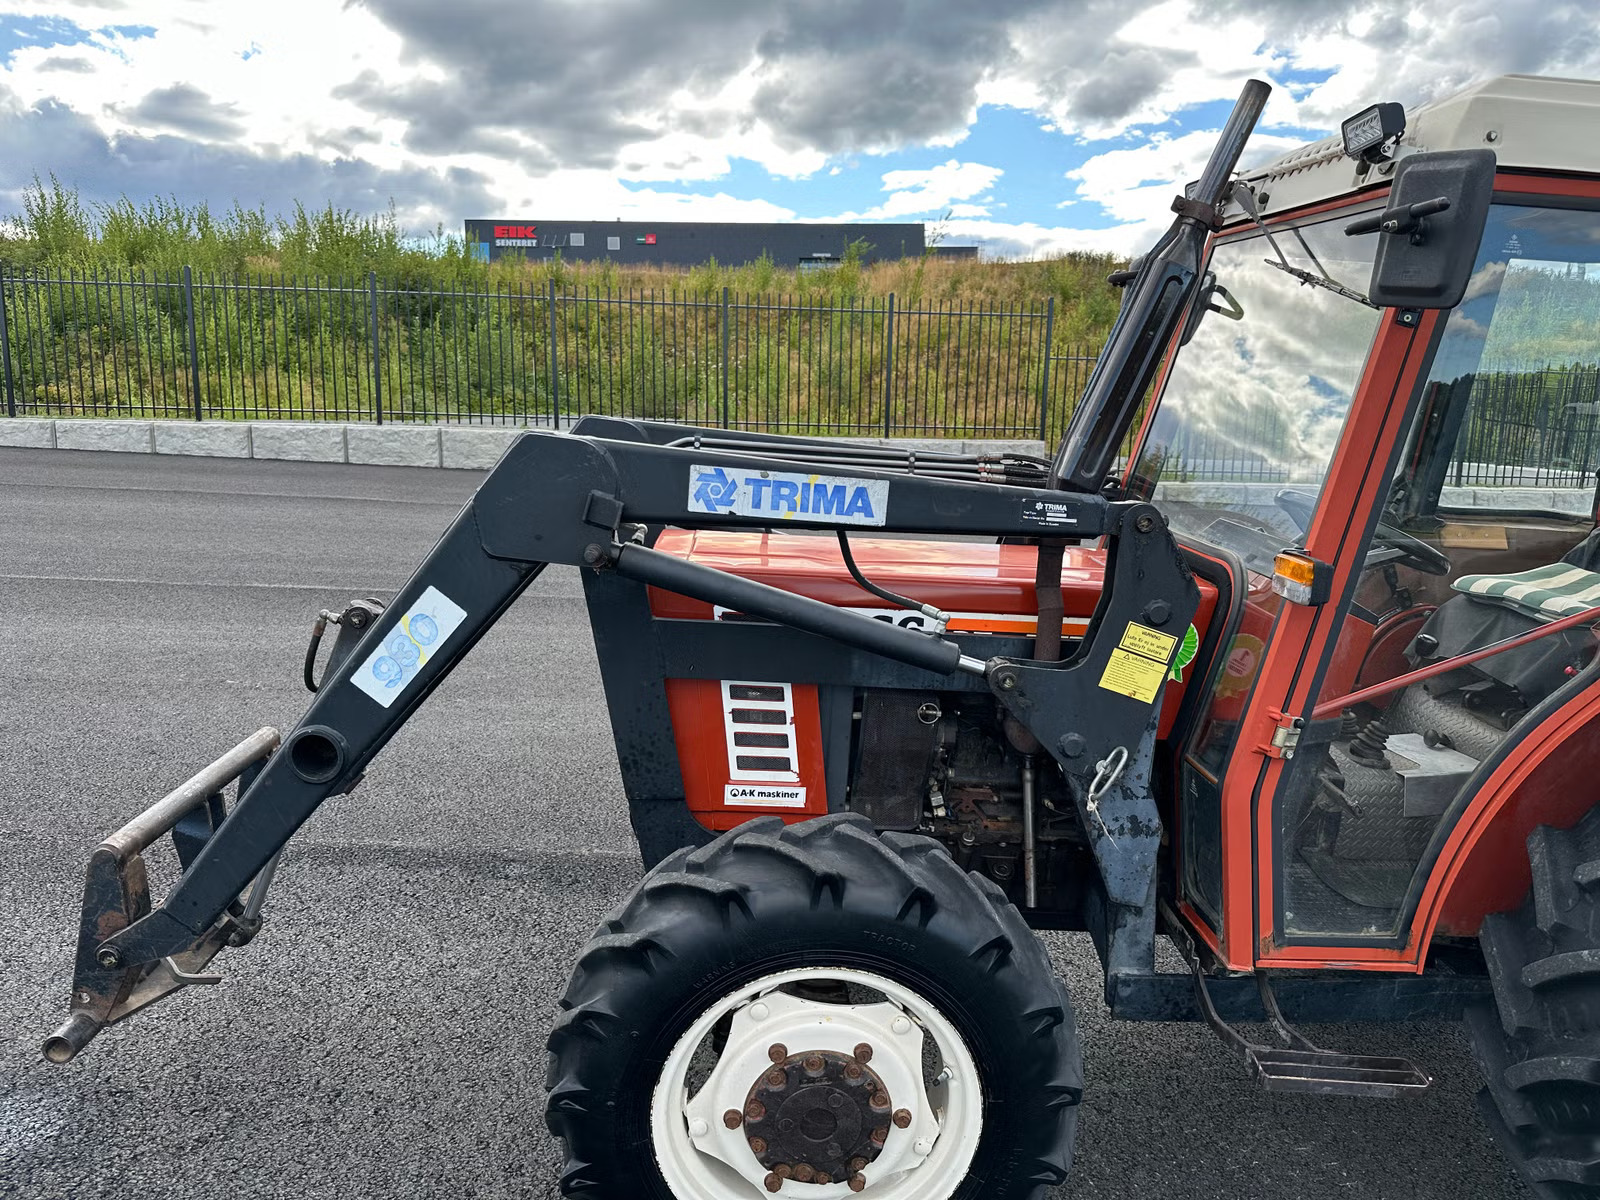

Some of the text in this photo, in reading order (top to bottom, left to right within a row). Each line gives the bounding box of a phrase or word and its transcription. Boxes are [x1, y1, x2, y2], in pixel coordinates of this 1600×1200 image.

[495, 226, 536, 238] EIK
[495, 239, 537, 247] SENTERET
[744, 477, 875, 519] TRIMA
[1044, 504, 1068, 512] TRIMA
[372, 612, 439, 689] 930
[758, 790, 800, 798] maskiner
